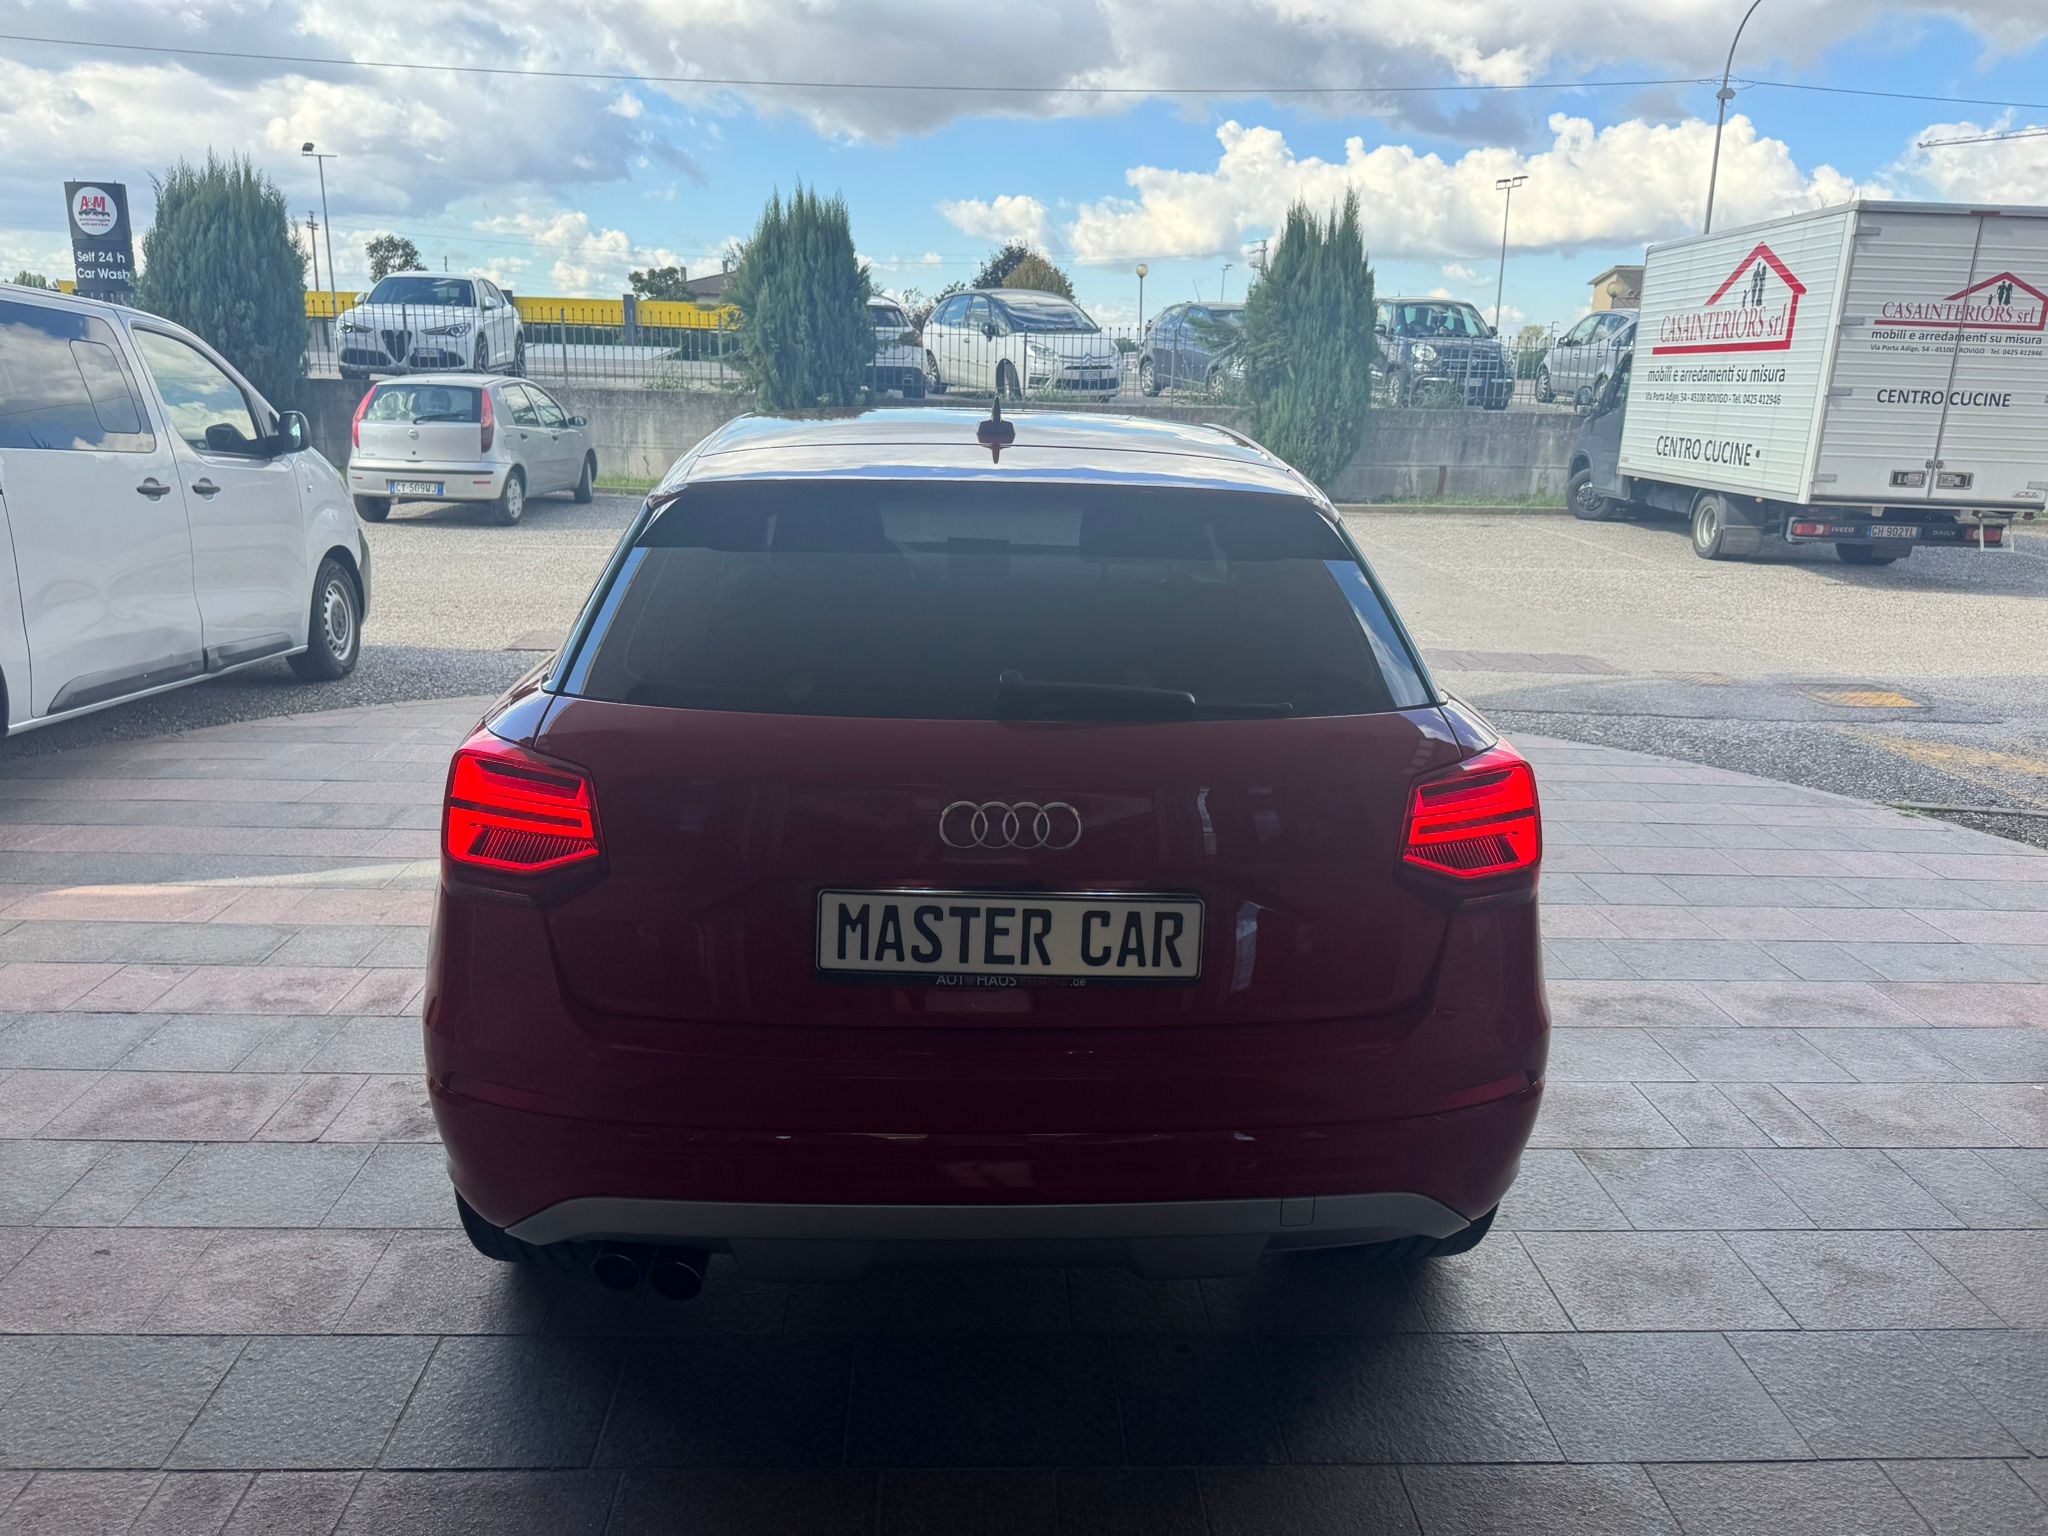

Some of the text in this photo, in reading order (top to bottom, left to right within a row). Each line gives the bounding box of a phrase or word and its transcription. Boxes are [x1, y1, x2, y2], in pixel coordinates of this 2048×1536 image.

[77, 251, 126, 264] Self 24 h
[77, 268, 130, 280] Car Wash
[1882, 301, 2035, 324] CASAINTERIORS srl
[1660, 303, 1788, 343] CASAINTERIORS srl
[1871, 329, 2042, 345] mobili e arredamenti su misura
[1881, 344, 1899, 352] Porta
[1647, 364, 1786, 383] mobili e arredamenti su misura
[1877, 389, 2012, 408] CENTRO CUCINE
[1656, 435, 1753, 466] CENTRO CUCINE
[1831, 526, 1855, 534] IVECO
[836, 903, 1185, 968] MASTER CAR
